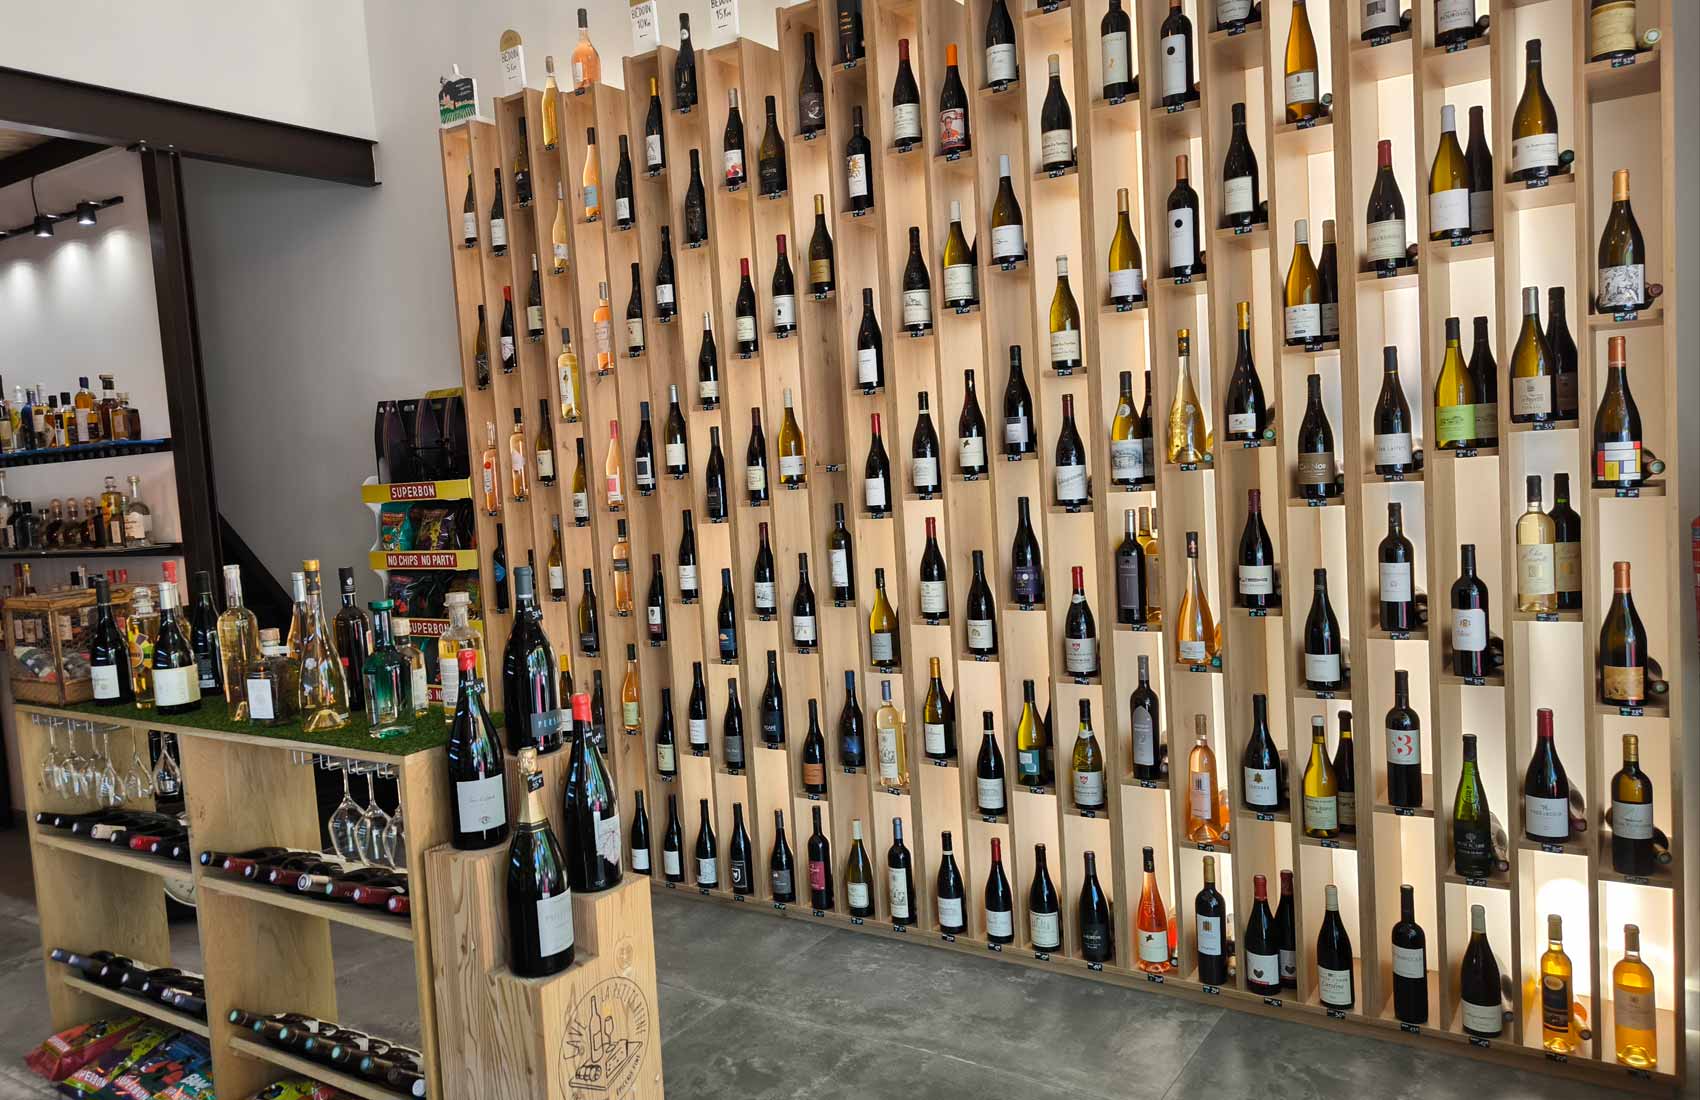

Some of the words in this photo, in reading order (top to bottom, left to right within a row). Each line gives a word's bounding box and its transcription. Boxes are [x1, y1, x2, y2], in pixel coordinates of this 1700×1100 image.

[391, 485, 435, 498] SUPERBON
[387, 555, 398, 567] NO
[399, 555, 418, 566] CHIPS
[420, 555, 431, 566] NO
[432, 555, 454, 566] PARTY
